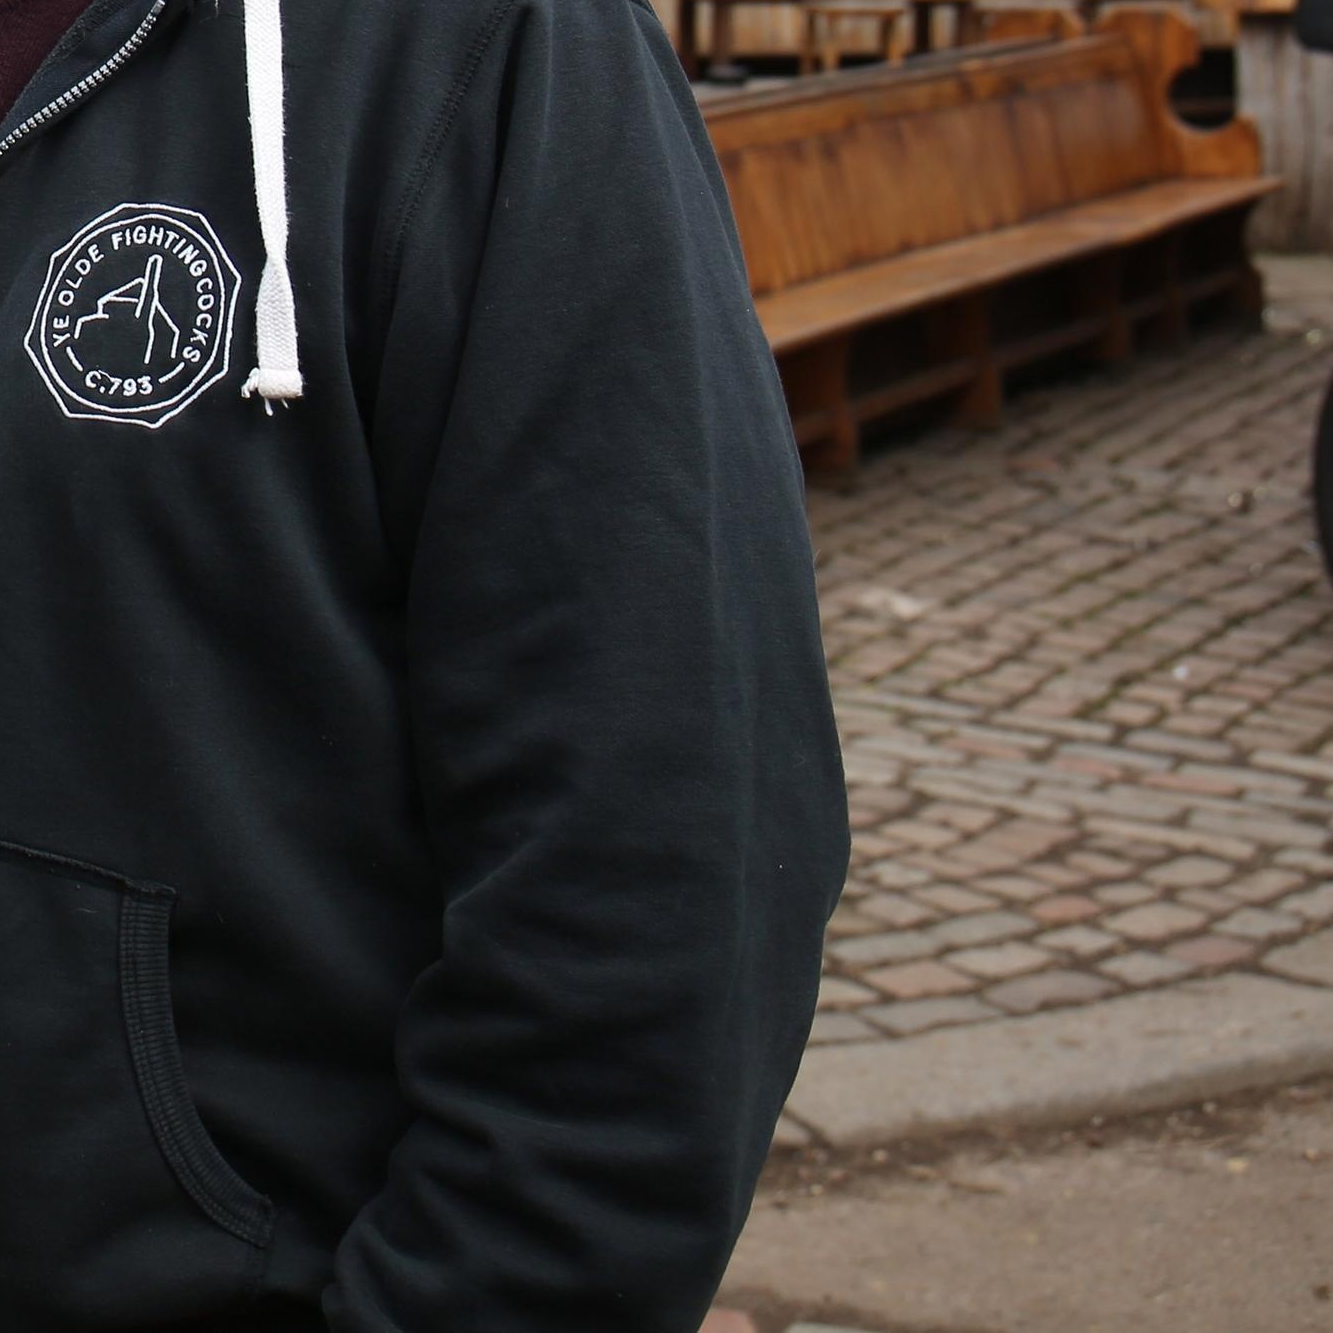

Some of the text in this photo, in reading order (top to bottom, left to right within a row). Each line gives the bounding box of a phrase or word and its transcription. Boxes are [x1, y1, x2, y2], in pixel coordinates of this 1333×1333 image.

[58, 243, 105, 307] OLDE
[52, 314, 71, 348] YE
[84, 370, 153, 397] C.793
